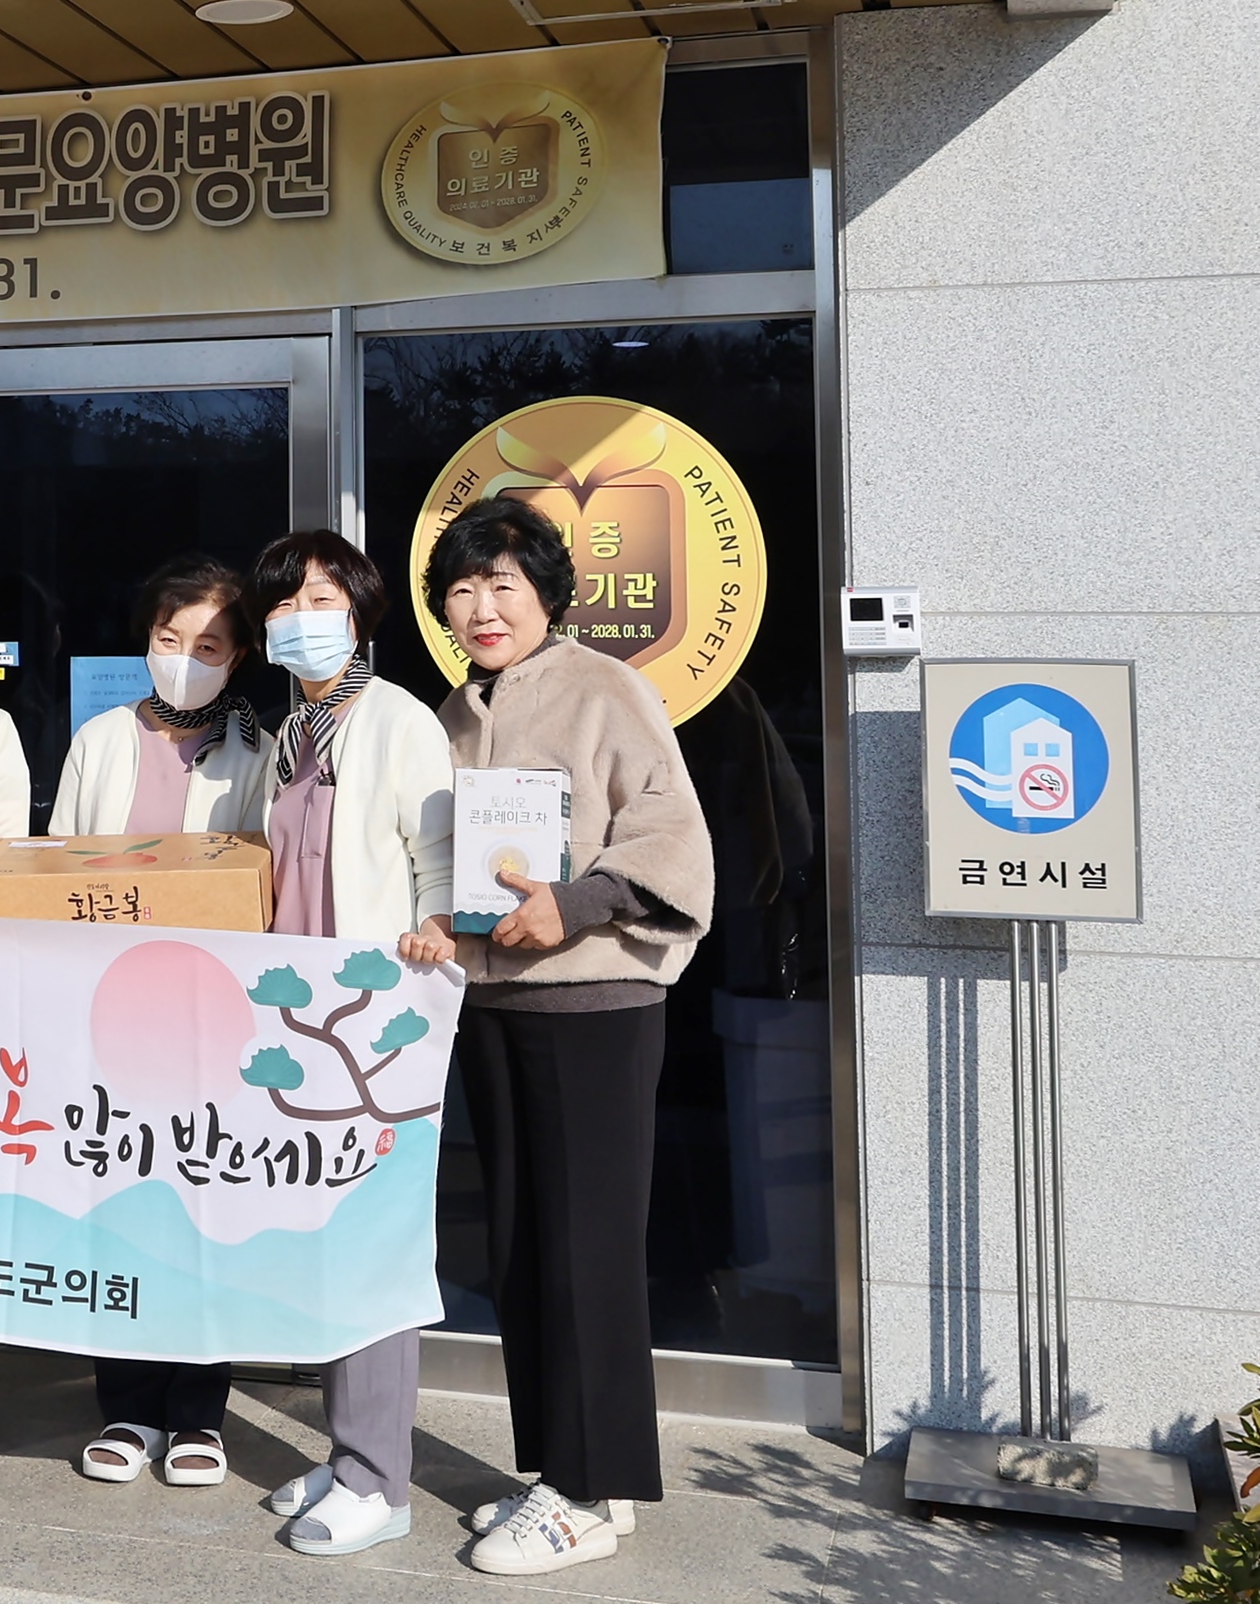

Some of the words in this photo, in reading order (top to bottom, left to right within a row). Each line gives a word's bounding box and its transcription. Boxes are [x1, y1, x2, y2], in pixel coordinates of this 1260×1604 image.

[561, 110, 592, 168] PATIENT
[394, 125, 427, 208] HEALTHCARE
[469, 146, 519, 169] 인증
[446, 168, 540, 197] 의료기관
[403, 211, 447, 247] QUALITY
[684, 465, 741, 568] PATIENT
[686, 582, 741, 680] SAFETY
[469, 809, 531, 824] 콘플레이크
[535, 812, 547, 825] 차
[491, 796, 526, 809] 토시오
[959, 859, 1108, 889] 금연시설
[68, 886, 142, 922] 황금봉
[64, 1085, 152, 1178] 많이
[171, 1102, 378, 1187] 받으세요
